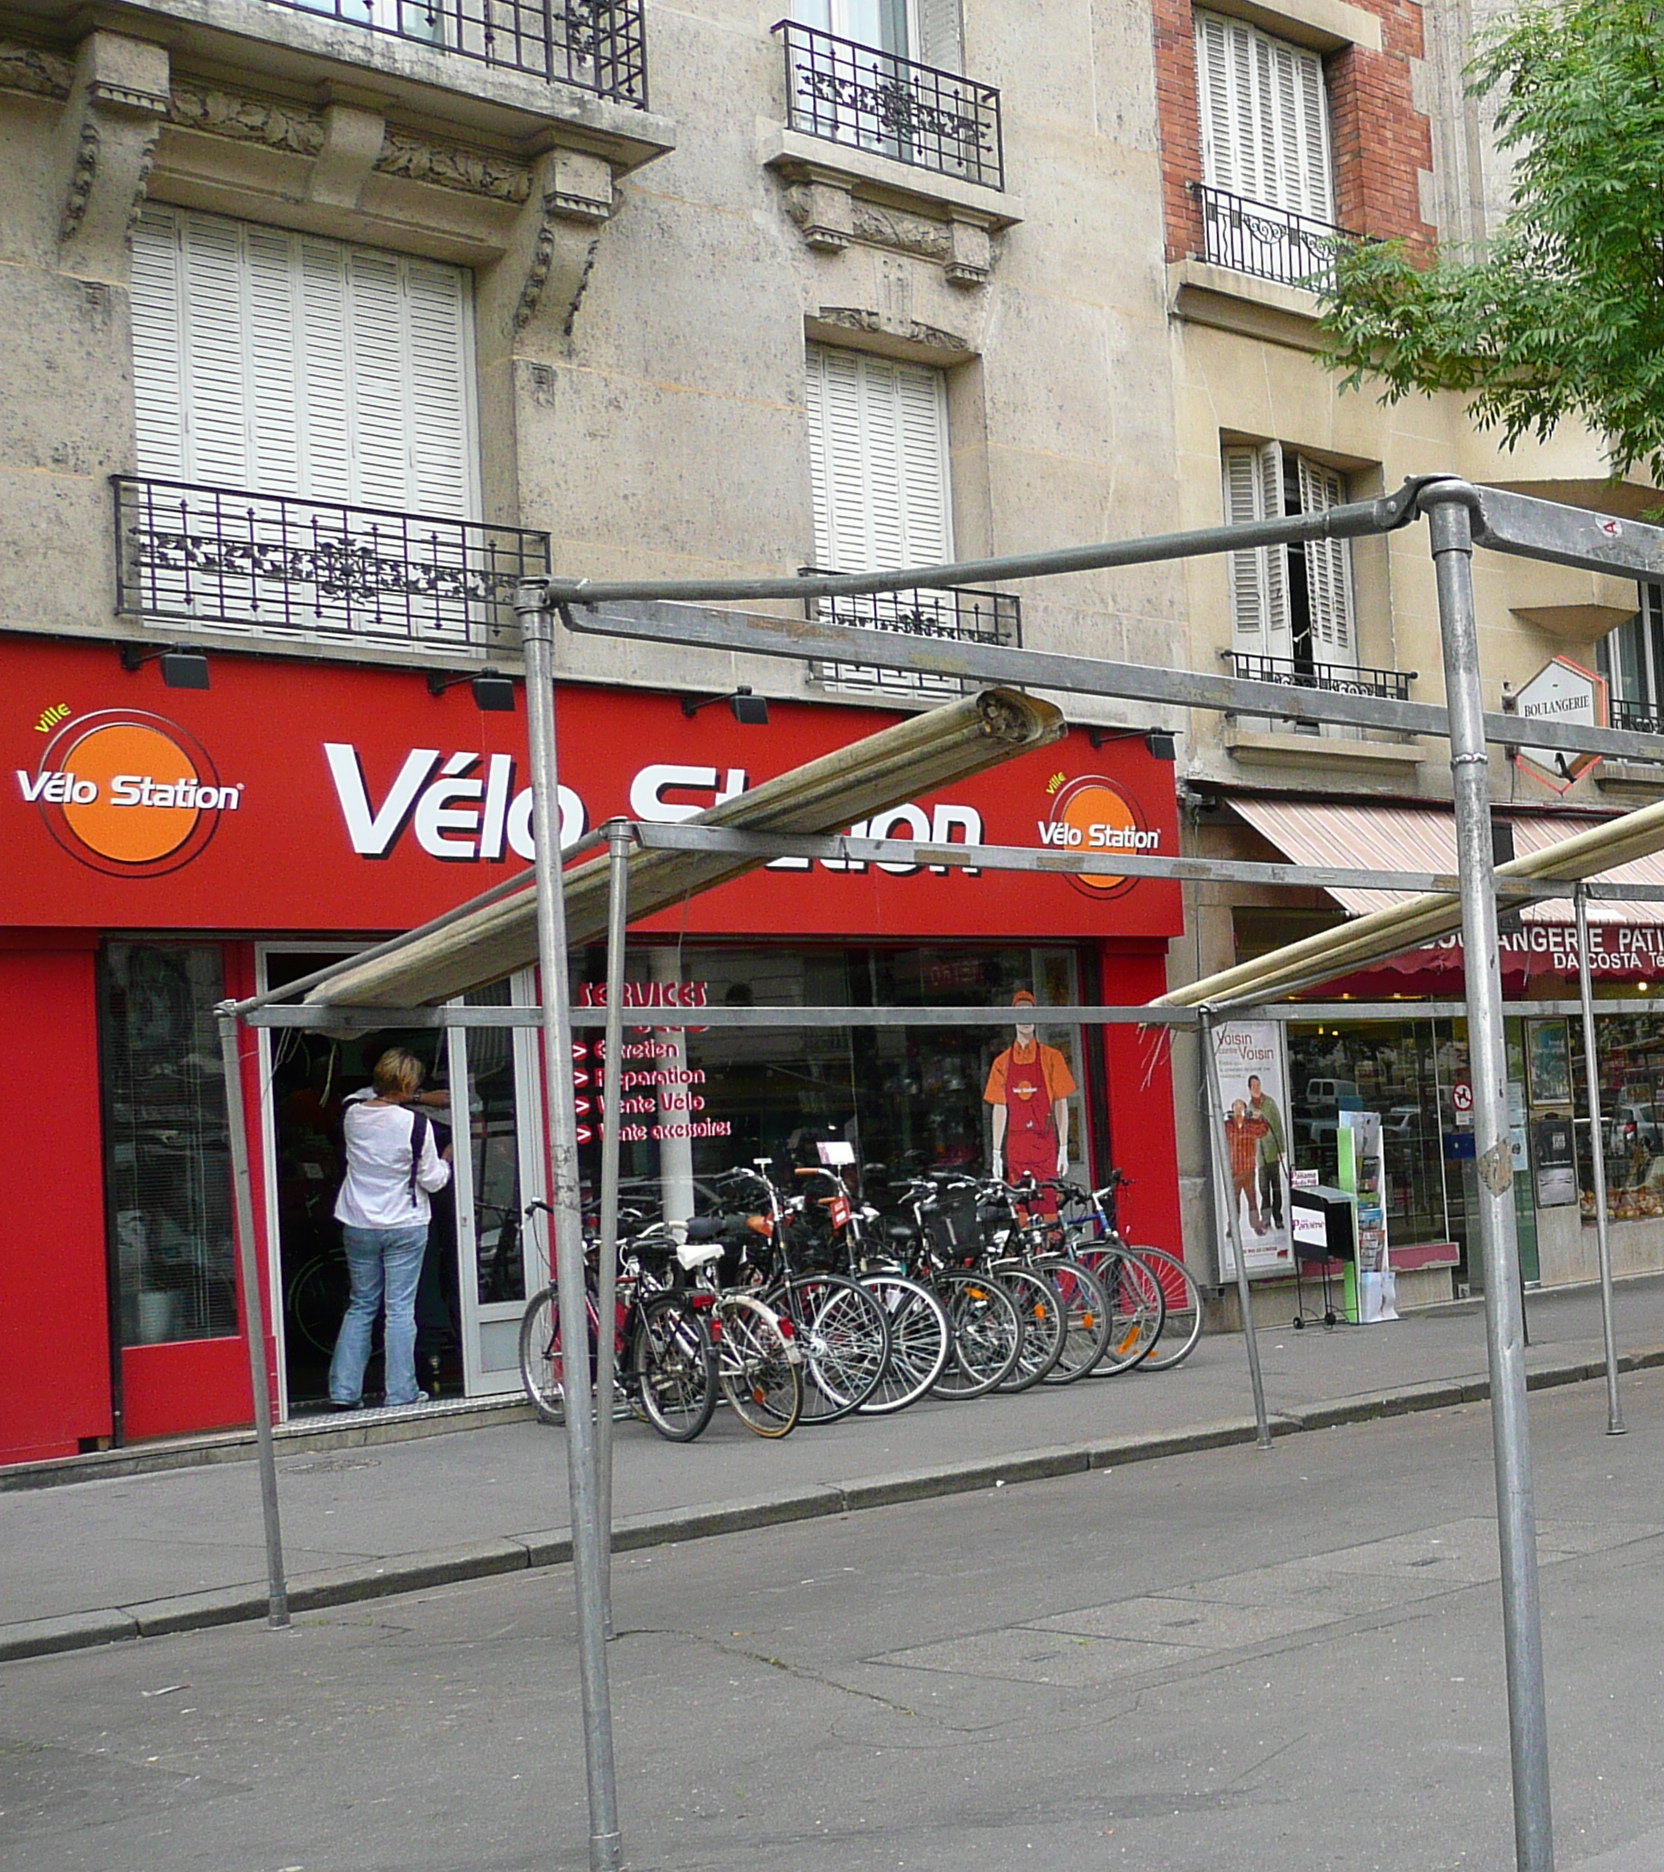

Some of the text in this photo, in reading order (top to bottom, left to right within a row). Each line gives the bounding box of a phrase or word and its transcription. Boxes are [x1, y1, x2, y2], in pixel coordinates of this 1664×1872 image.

[34, 702, 72, 734] ville
[1524, 694, 1589, 718] BOULANGERIE
[16, 769, 241, 810] Vélo Station
[1045, 771, 1067, 795] ville
[323, 741, 586, 858] Vélo
[1037, 820, 1159, 849] Vélo Station
[1554, 950, 1580, 971] DA
[1587, 951, 1642, 971] COSTA
[578, 982, 708, 1008] SERVICES
[593, 1038, 680, 1059] Eretien
[1216, 1031, 1253, 1046] Voisin
[1238, 1045, 1275, 1061] Voisin
[594, 1065, 706, 1092] Rparation
[660, 1091, 705, 1112] Vélo
[598, 1123, 648, 1142] Vnte
